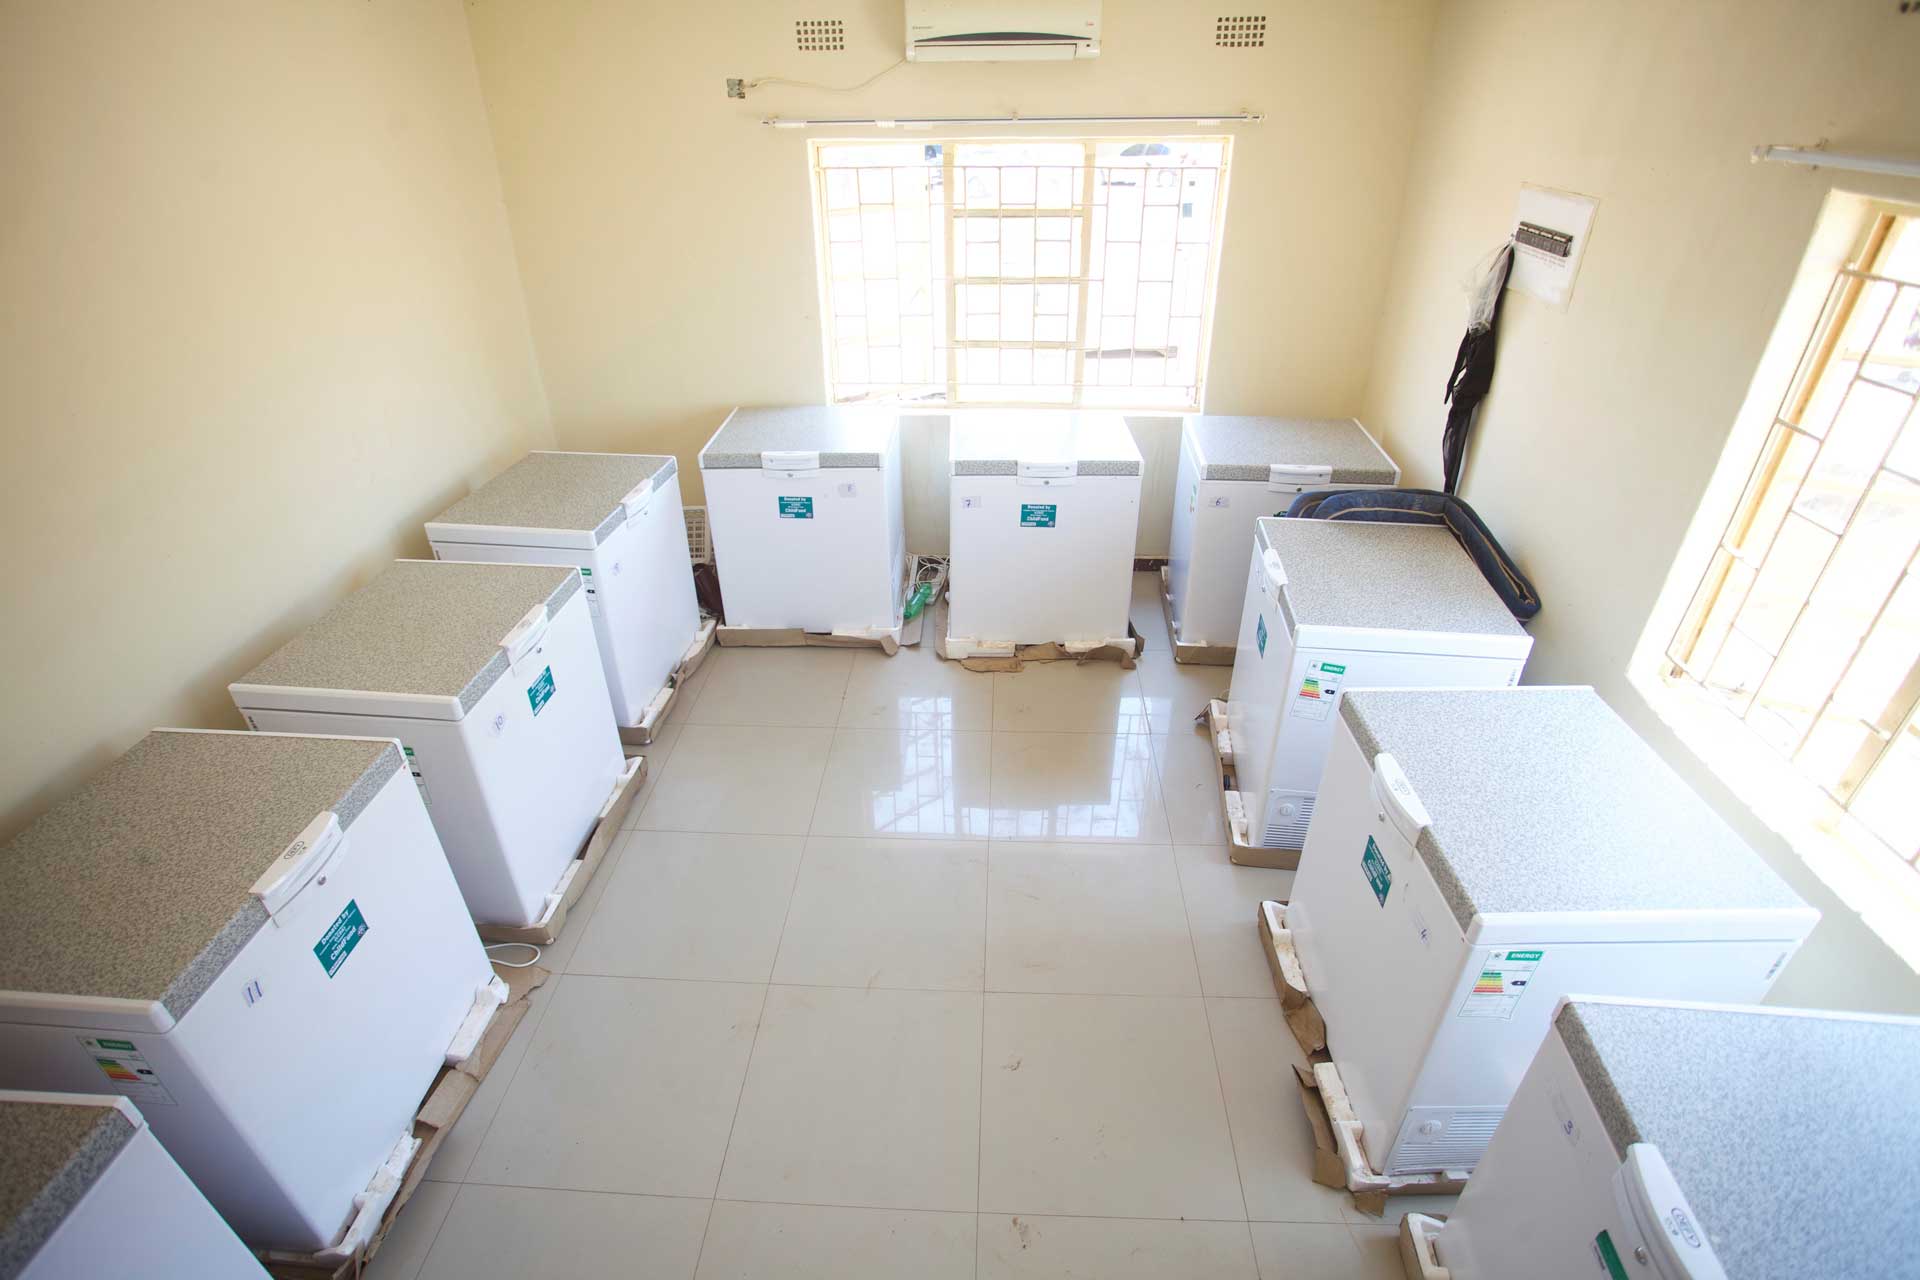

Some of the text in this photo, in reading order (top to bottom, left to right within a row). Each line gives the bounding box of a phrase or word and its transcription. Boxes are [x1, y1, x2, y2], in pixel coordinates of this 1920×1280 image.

[495, 715, 504, 731] 10
[321, 917, 342, 945] Donated
[330, 925, 357, 960] ChildFund
[247, 980, 263, 1004] 11
